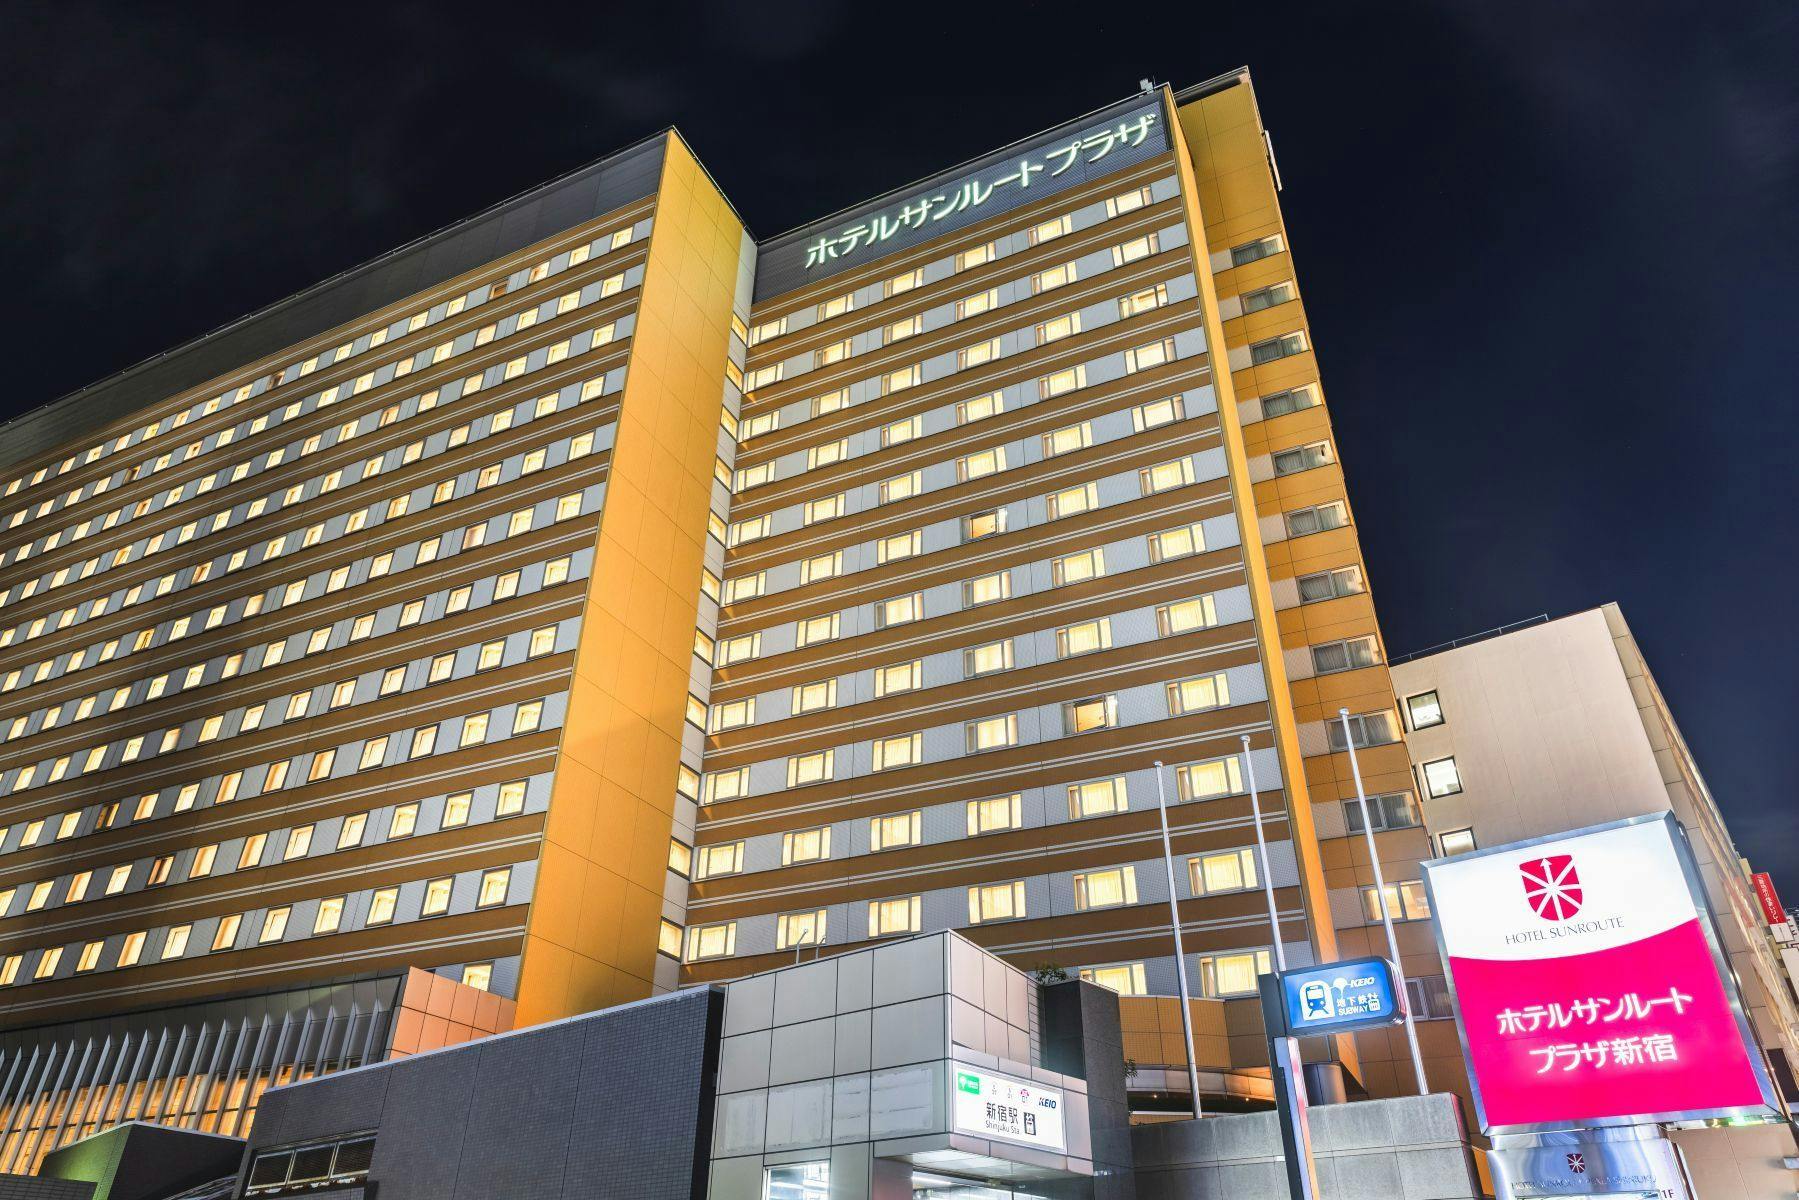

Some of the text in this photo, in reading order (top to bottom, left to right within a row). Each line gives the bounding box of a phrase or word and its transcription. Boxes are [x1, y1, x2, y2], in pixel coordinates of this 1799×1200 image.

[1505, 916, 1625, 945] HOTEL SUNROUTE
[1350, 977, 1375, 988] KEIO
[1338, 1005, 1368, 1016] SUBWAY
[1496, 987, 1693, 1034] ホテルサンルート
[1529, 1035, 1678, 1074] プラザ新宿
[1038, 1097, 1057, 1109] KEIO
[986, 1102, 1018, 1124] 新宿駅
[985, 1120, 1010, 1133] Shinjuku
[1661, 1189, 1675, 1199] 1F
